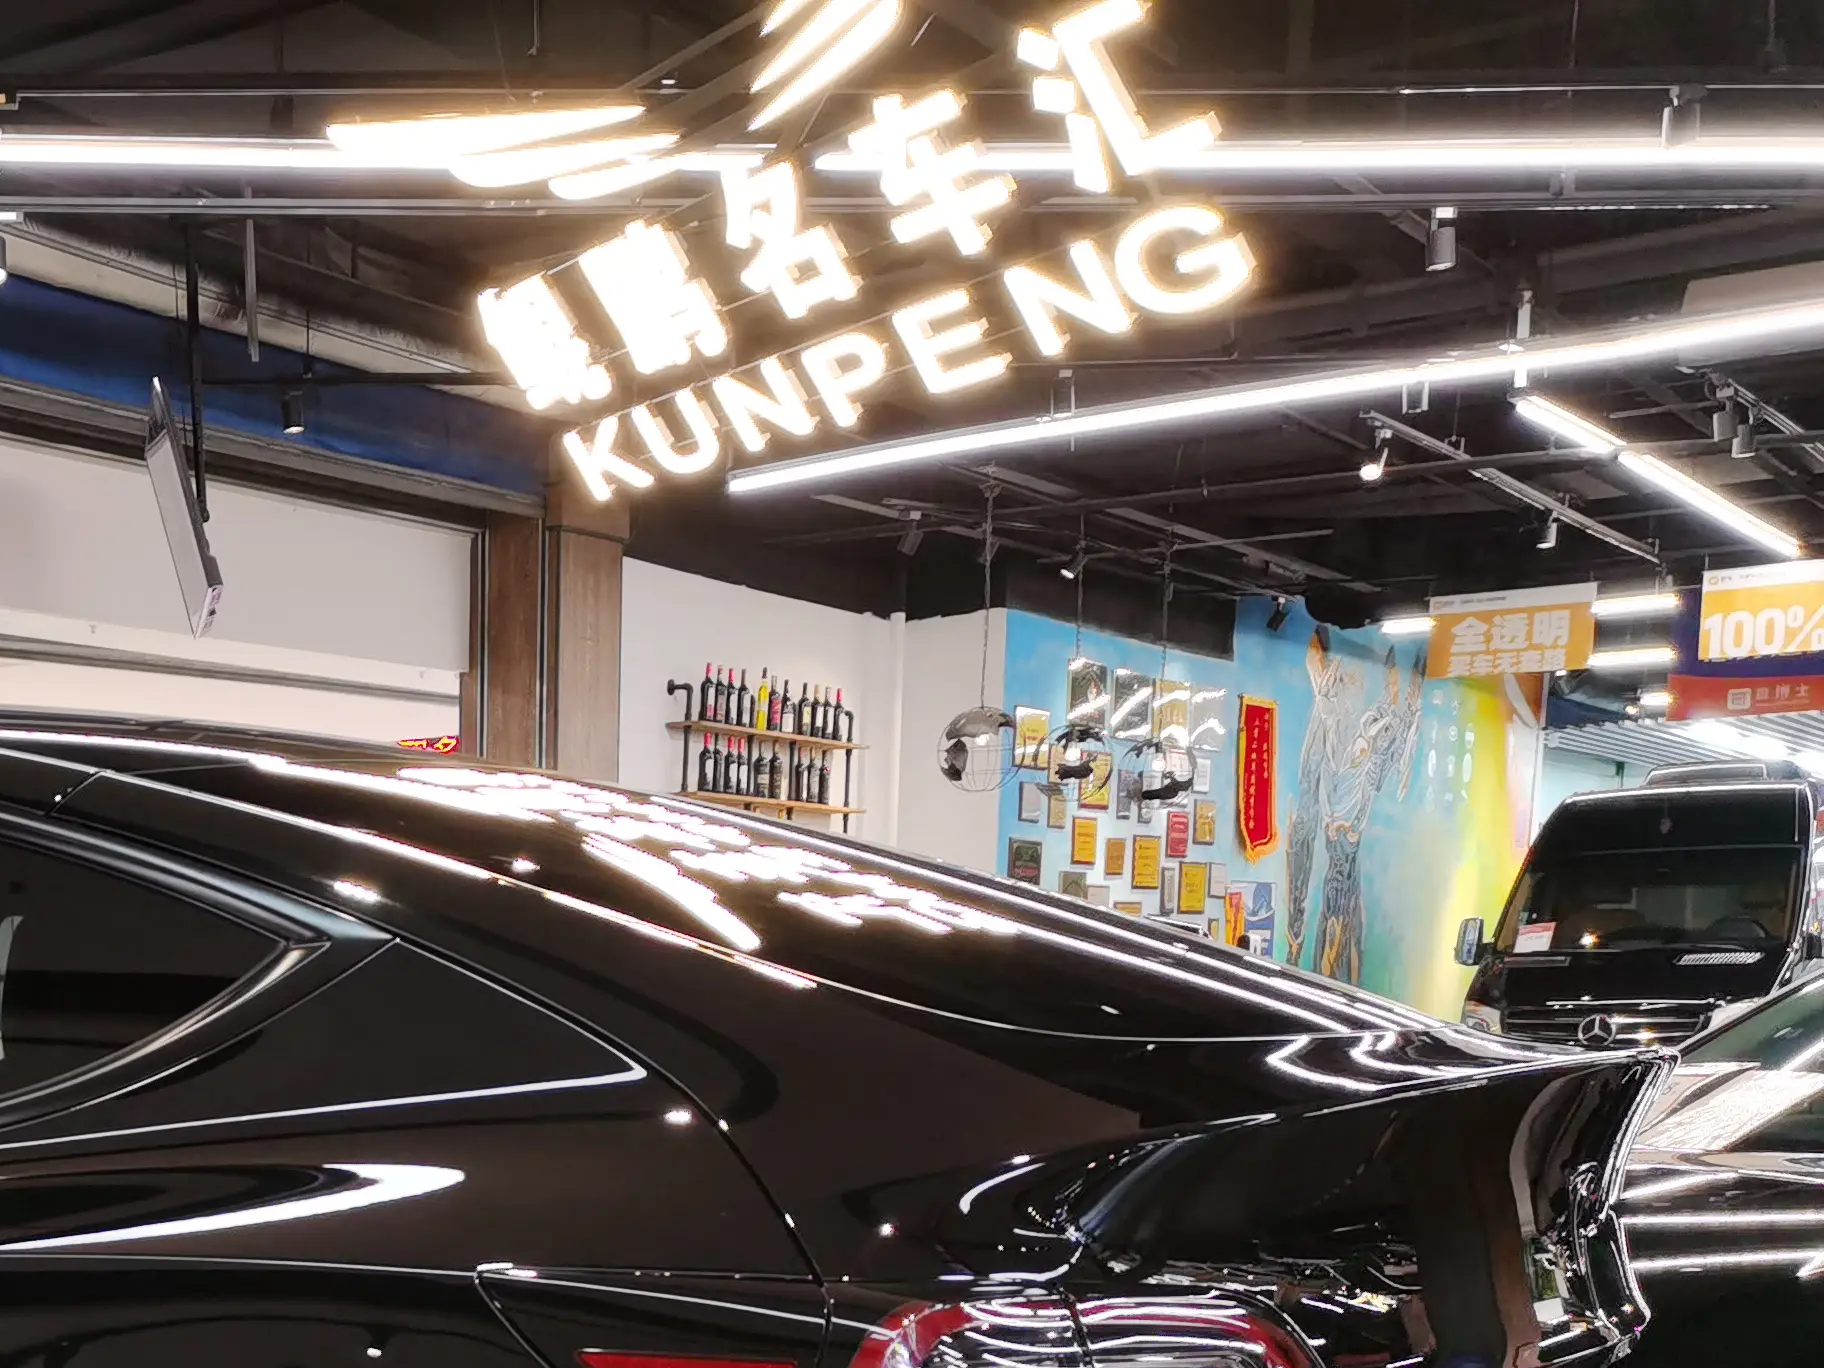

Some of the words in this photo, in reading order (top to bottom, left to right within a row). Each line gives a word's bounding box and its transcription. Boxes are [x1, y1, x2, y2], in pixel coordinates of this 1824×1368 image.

[563, 205, 1256, 502] KUNPENG
[1450, 609, 1571, 653] 全透明
[1703, 605, 1824, 661] 100%
